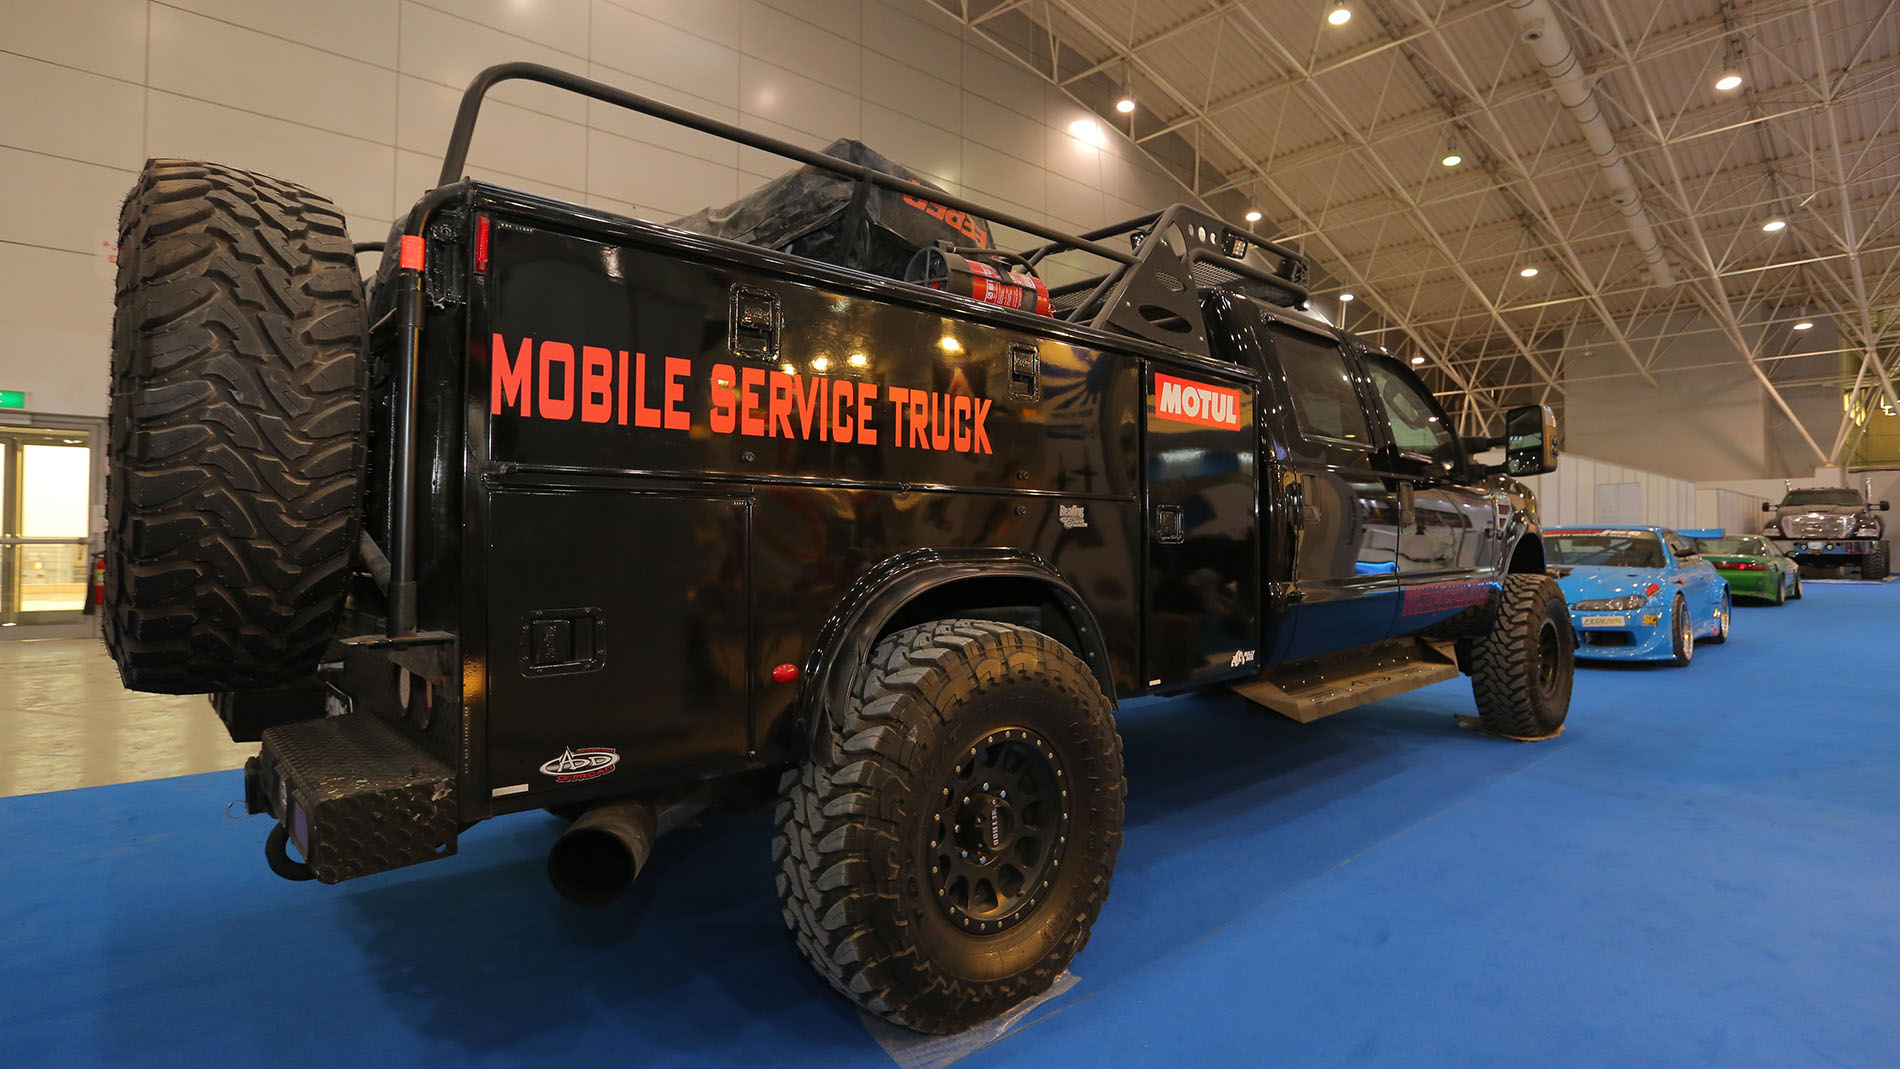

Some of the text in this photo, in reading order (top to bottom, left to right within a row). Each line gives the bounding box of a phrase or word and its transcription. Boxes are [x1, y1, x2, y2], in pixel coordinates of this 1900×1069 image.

[491, 333, 993, 455] MOBILE SERVICE TRUCK
[1160, 382, 1237, 424] MOTUL
